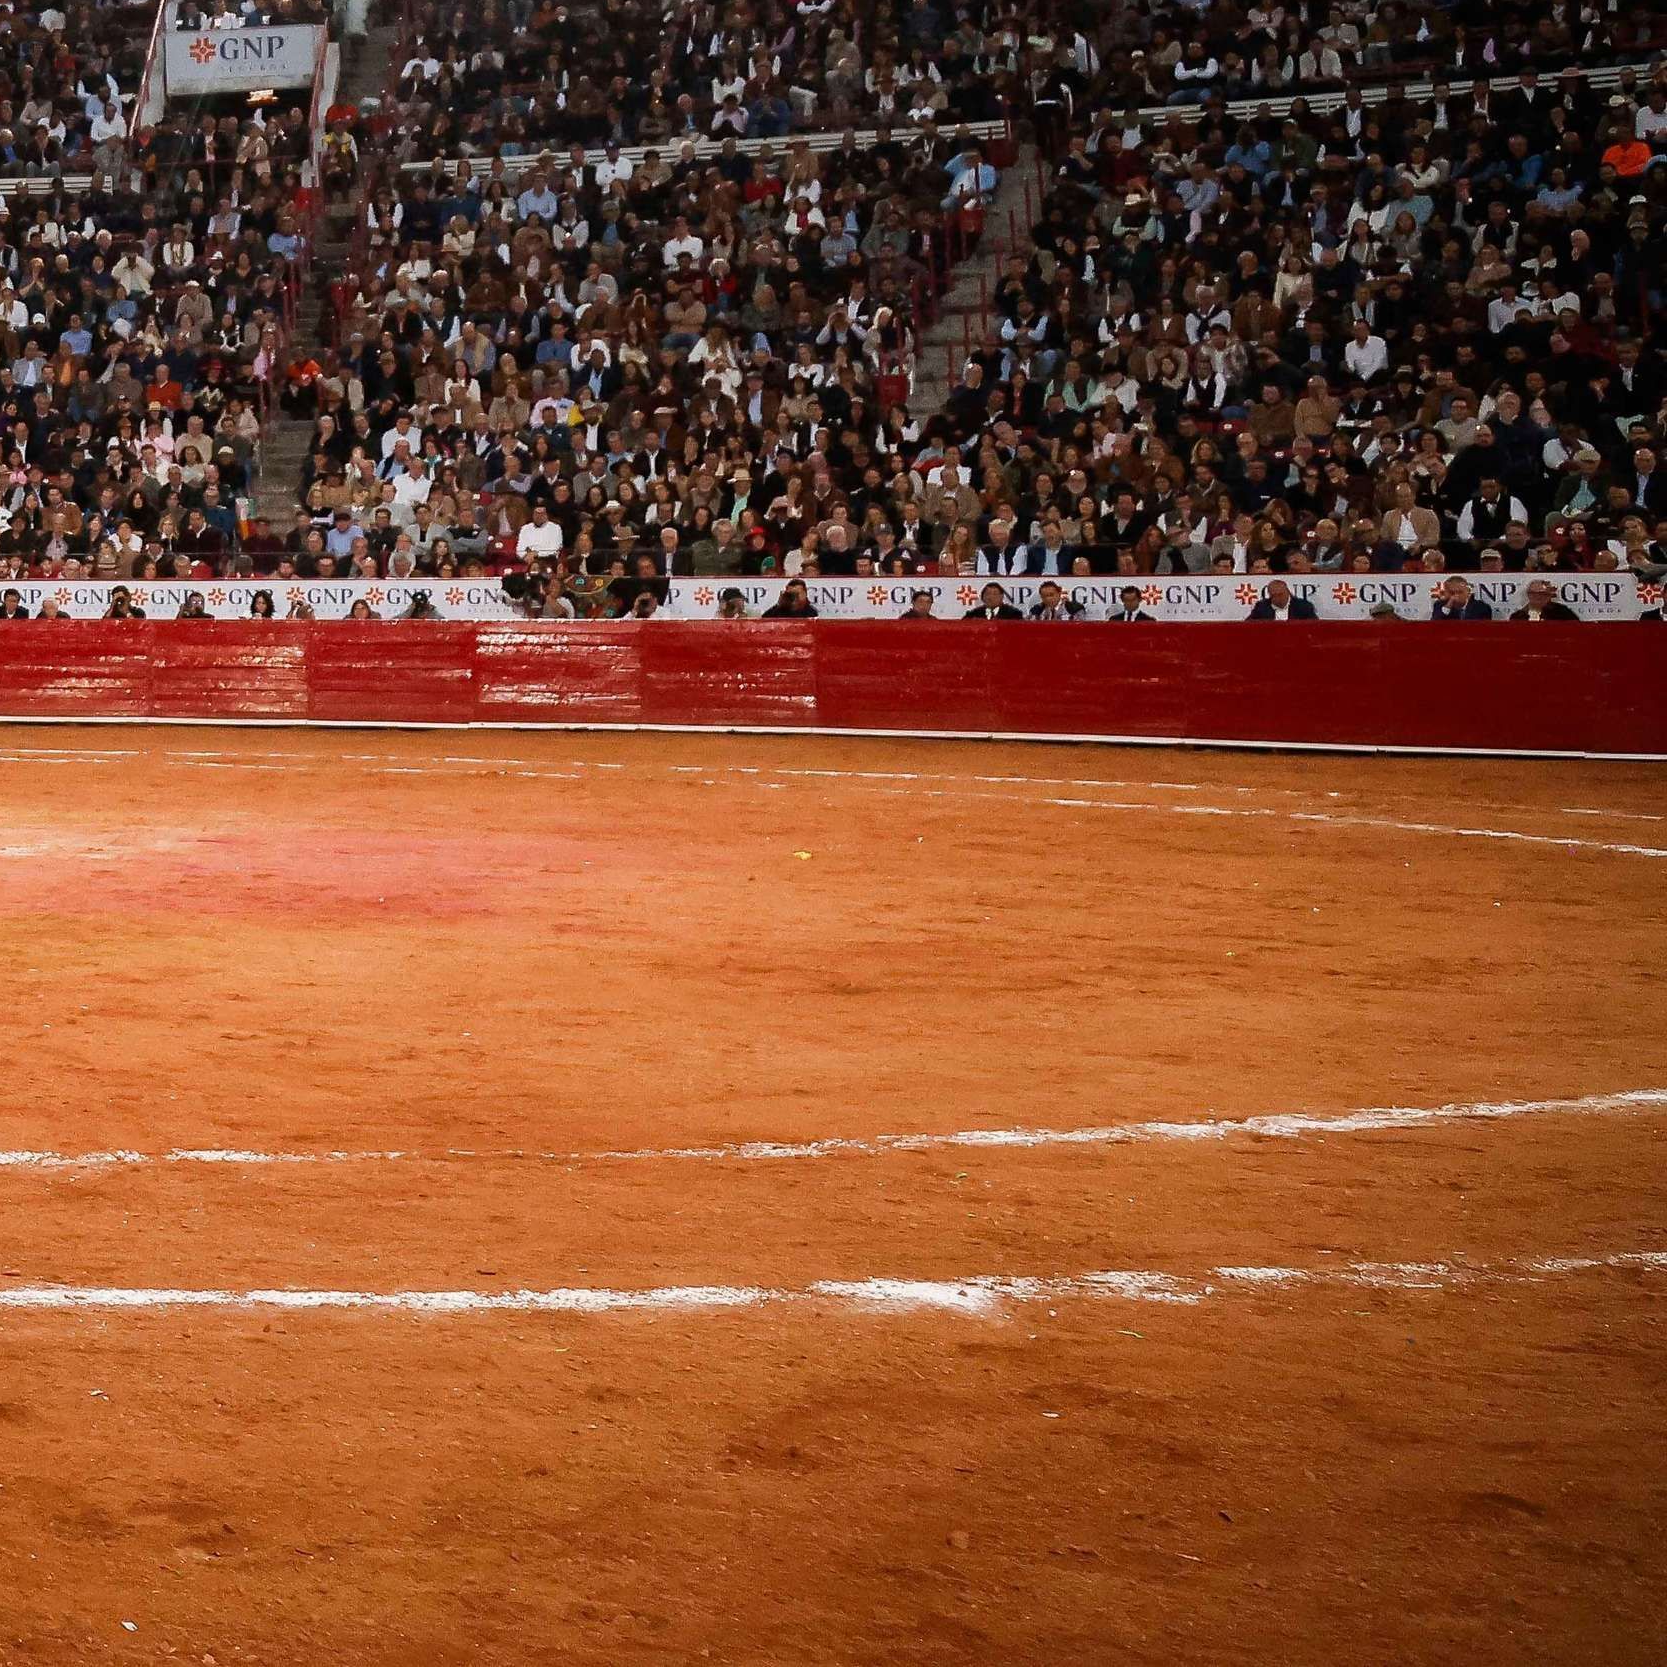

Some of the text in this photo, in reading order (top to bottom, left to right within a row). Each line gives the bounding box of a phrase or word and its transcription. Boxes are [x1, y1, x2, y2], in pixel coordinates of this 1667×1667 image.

[219, 35, 285, 61] GNP
[307, 588, 353, 604] GNP
[807, 587, 853, 604] GNP
[1165, 584, 1220, 604] GNP
[1359, 583, 1417, 603] GNP
[1560, 582, 1621, 603] GNP
